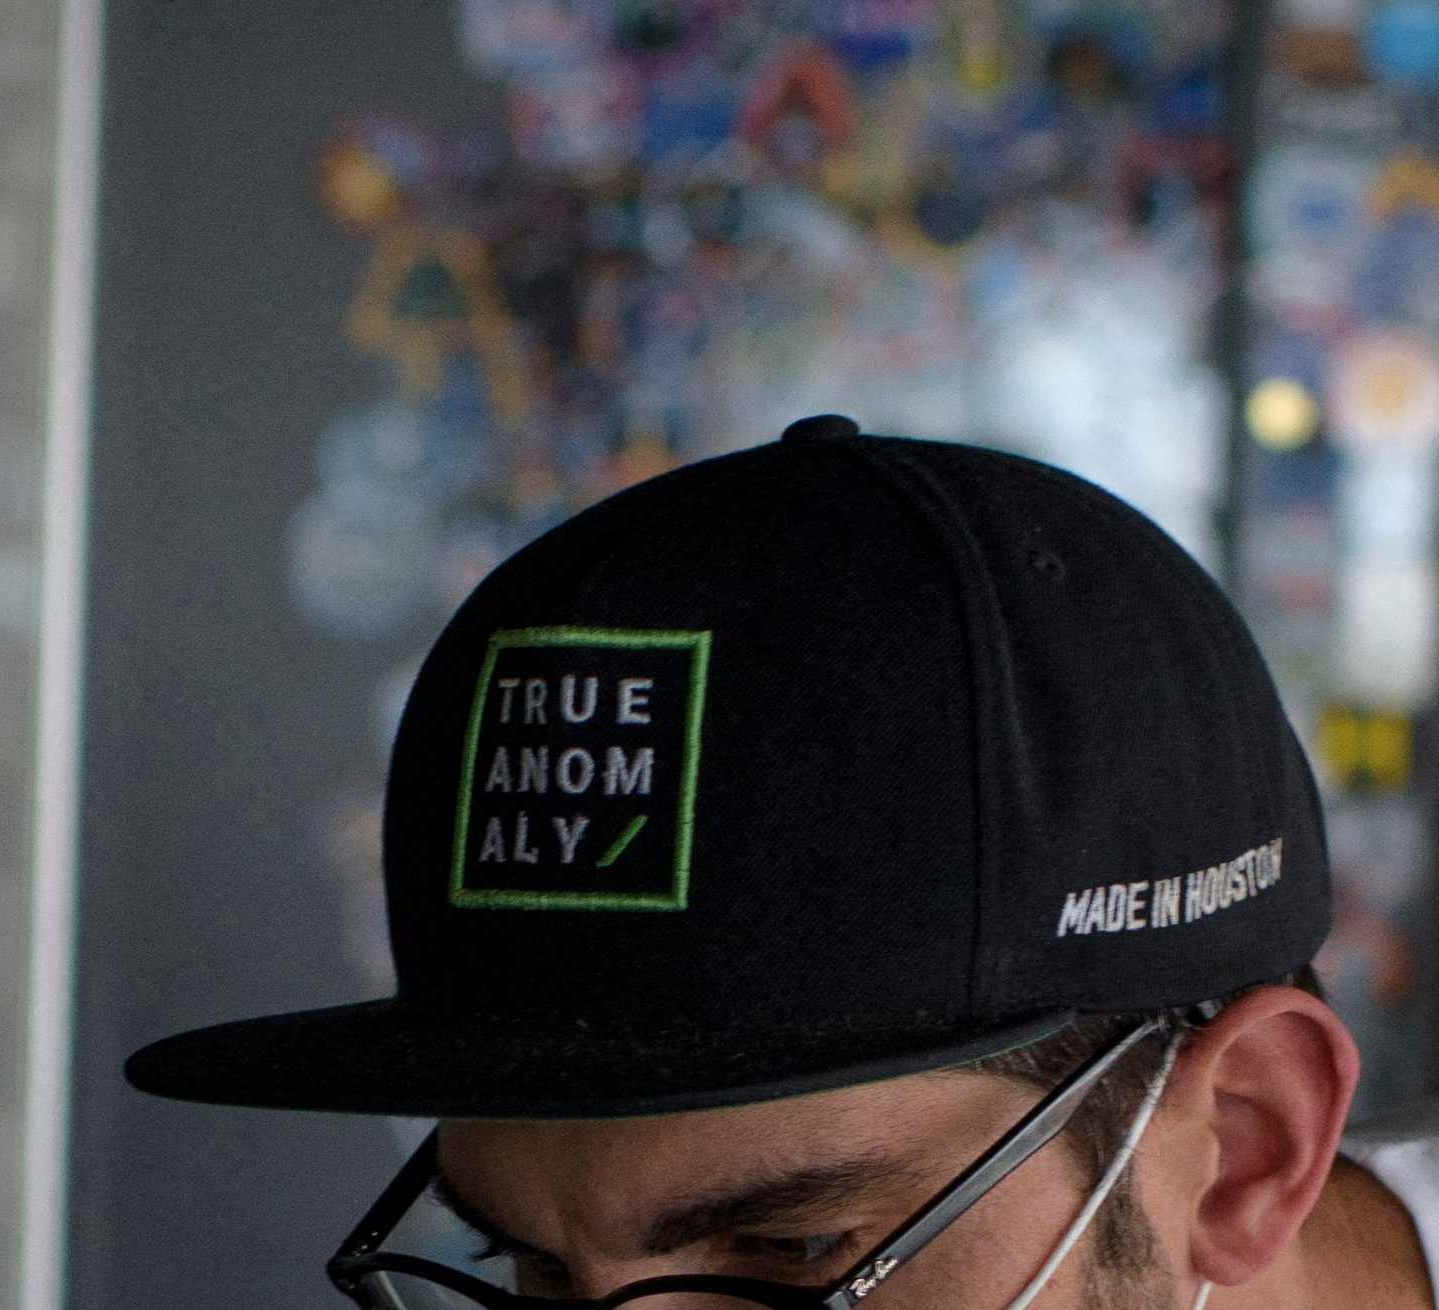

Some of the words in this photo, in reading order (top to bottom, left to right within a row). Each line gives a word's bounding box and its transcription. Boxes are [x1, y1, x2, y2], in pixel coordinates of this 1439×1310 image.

[496, 672, 654, 726] TRUE
[484, 744, 656, 797] ANOM
[1057, 878, 1150, 938] MADE
[1151, 875, 1184, 929] IN
[1184, 837, 1284, 924] HOUSTON
